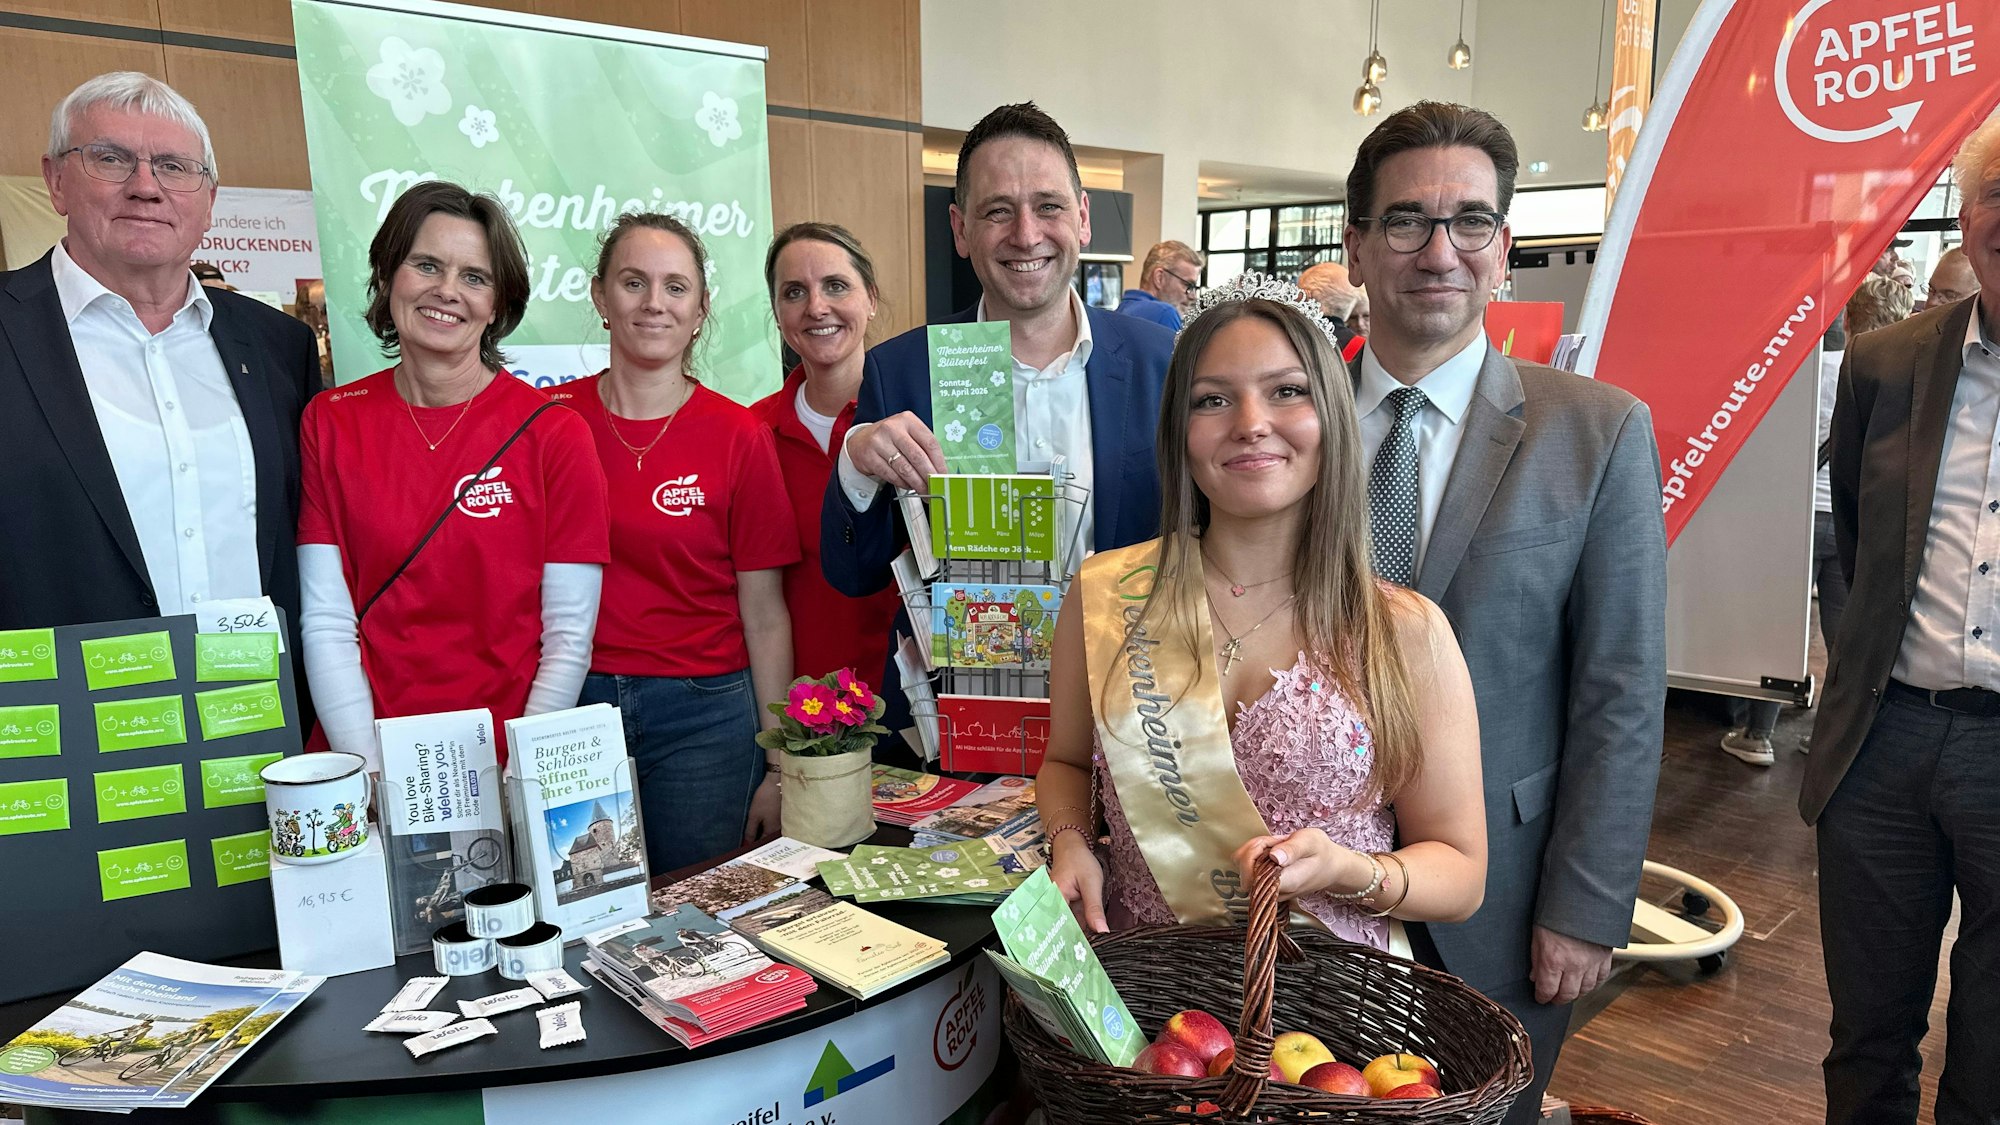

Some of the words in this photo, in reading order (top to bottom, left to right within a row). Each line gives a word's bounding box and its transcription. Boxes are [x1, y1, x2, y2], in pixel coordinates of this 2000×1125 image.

[1813, 1, 1974, 67] APFEL
[1813, 40, 1977, 107] ROUTE
[264, 216, 286, 230] ich
[196, 237, 313, 253] DRUCKENDEN
[937, 344, 1005, 356] Meckenheimer
[937, 356, 988, 369] Blütenfest
[342, 388, 369, 398] JAKO
[938, 379, 973, 388] Sonntag,
[940, 389, 950, 397] 19.
[951, 388, 970, 398] April
[1662, 294, 1816, 514] apfelroute.nrw
[465, 481, 511, 497] APFEL
[662, 487, 705, 499] APFEL
[465, 493, 514, 508] ROUTE
[662, 496, 706, 506] ROUTE
[967, 544, 998, 553] Rädche
[435, 740, 449, 769] you.
[534, 740, 586, 760] Burgen
[591, 735, 602, 748] &
[536, 750, 603, 773] Schlösser
[414, 742, 436, 824] Bike-Sharing?
[538, 767, 588, 787] öffnen
[405, 775, 417, 801] love
[437, 772, 453, 821] Welove
[540, 785, 573, 801] ihre
[576, 776, 610, 792] Tore
[407, 804, 420, 827] You
[456, 798, 464, 819] Sicher
[341, 888, 354, 902] €
[104, 981, 140, 994] durchs
[141, 988, 198, 1002] Rheinland
[112, 974, 132, 982] Mit
[132, 980, 156, 989] dem
[157, 984, 181, 993] Rad
[945, 982, 984, 1041] APFEL
[947, 994, 987, 1057] ROUTE
